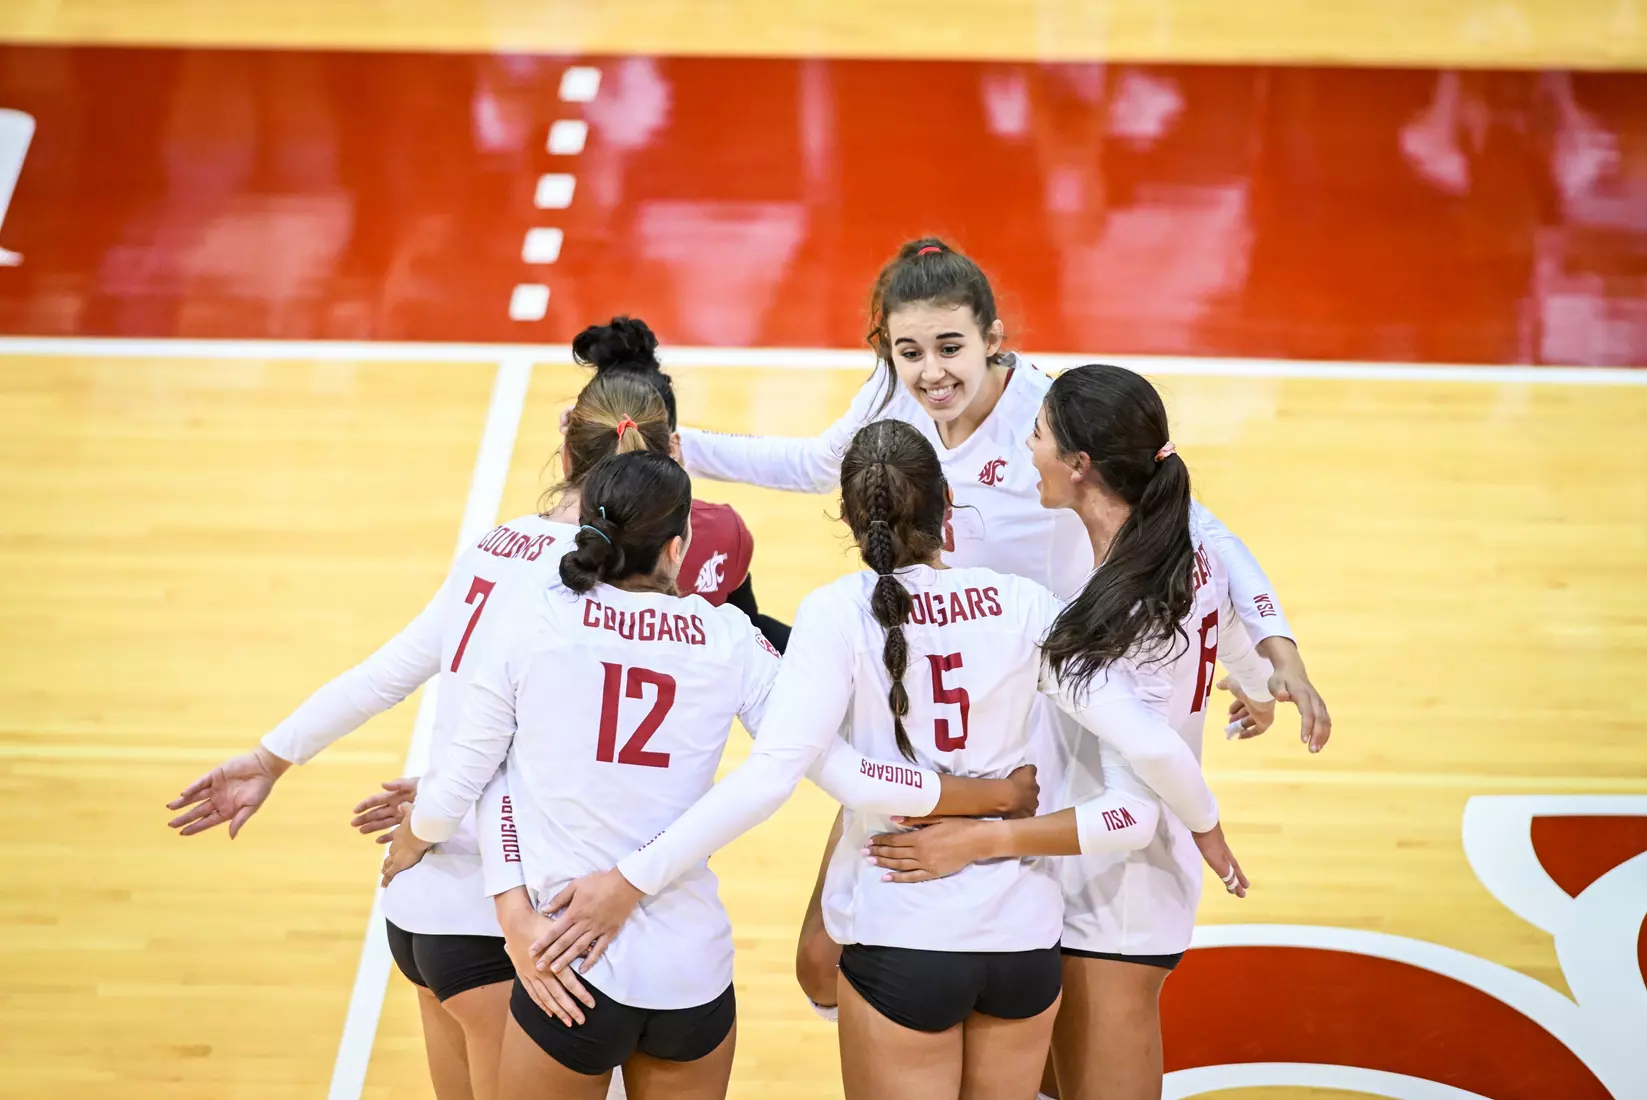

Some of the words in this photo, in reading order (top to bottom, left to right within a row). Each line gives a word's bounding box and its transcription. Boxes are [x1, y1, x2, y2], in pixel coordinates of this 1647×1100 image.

[450, 575, 496, 674] 7
[583, 598, 707, 646] COUGARS
[910, 586, 1003, 628] OUGARS
[1253, 593, 1277, 618] WSU
[596, 661, 677, 768] 12
[927, 651, 970, 753] 5
[860, 758, 923, 789] COUGARS
[1101, 806, 1137, 831] WSU
